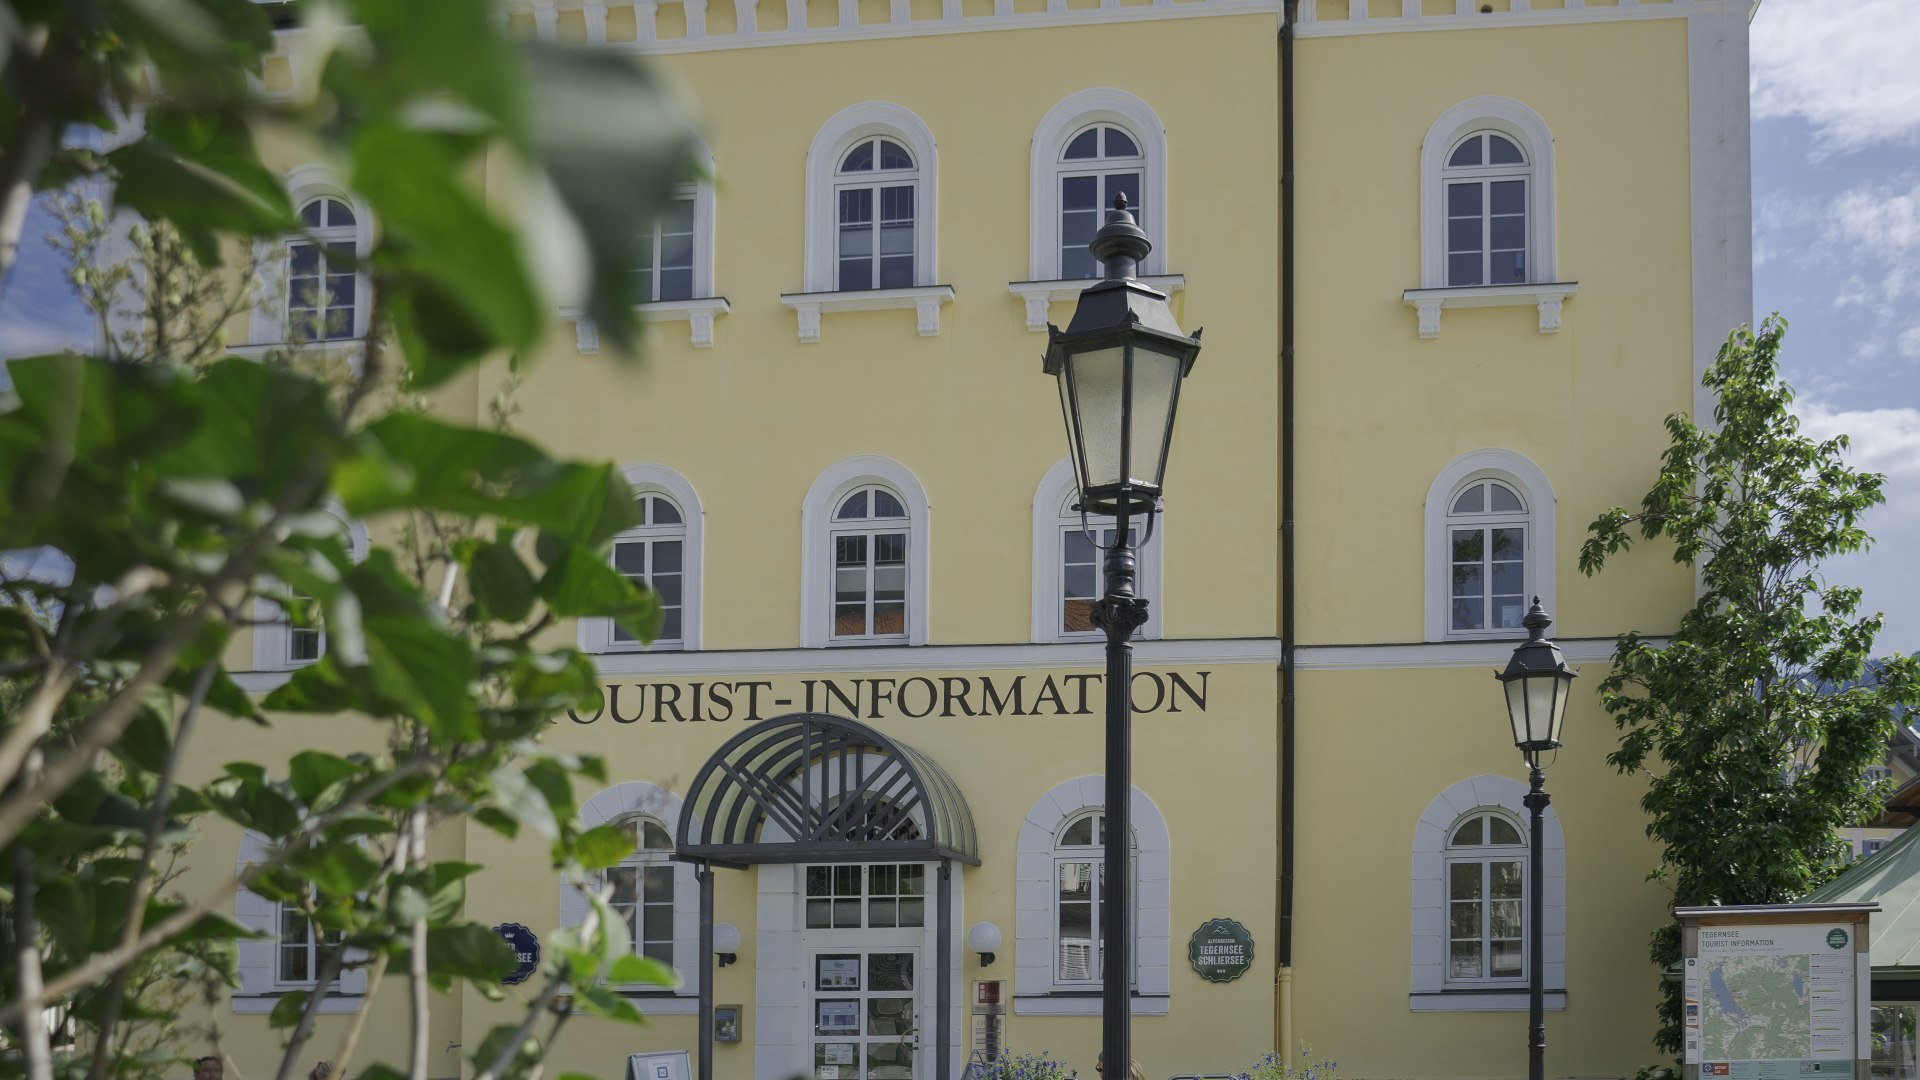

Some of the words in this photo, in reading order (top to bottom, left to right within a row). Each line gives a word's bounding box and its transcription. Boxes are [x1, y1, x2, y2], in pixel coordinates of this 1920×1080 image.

[540, 671, 1212, 725] OURIST-INFORMATON
[1701, 930, 1740, 939] TEGERNSEE
[1701, 939, 1729, 948] TOURIST
[1730, 938, 1774, 947] INFORMATION
[1199, 945, 1244, 955] TEGERNSEE
[1198, 955, 1245, 966] SCHLIERSEE
